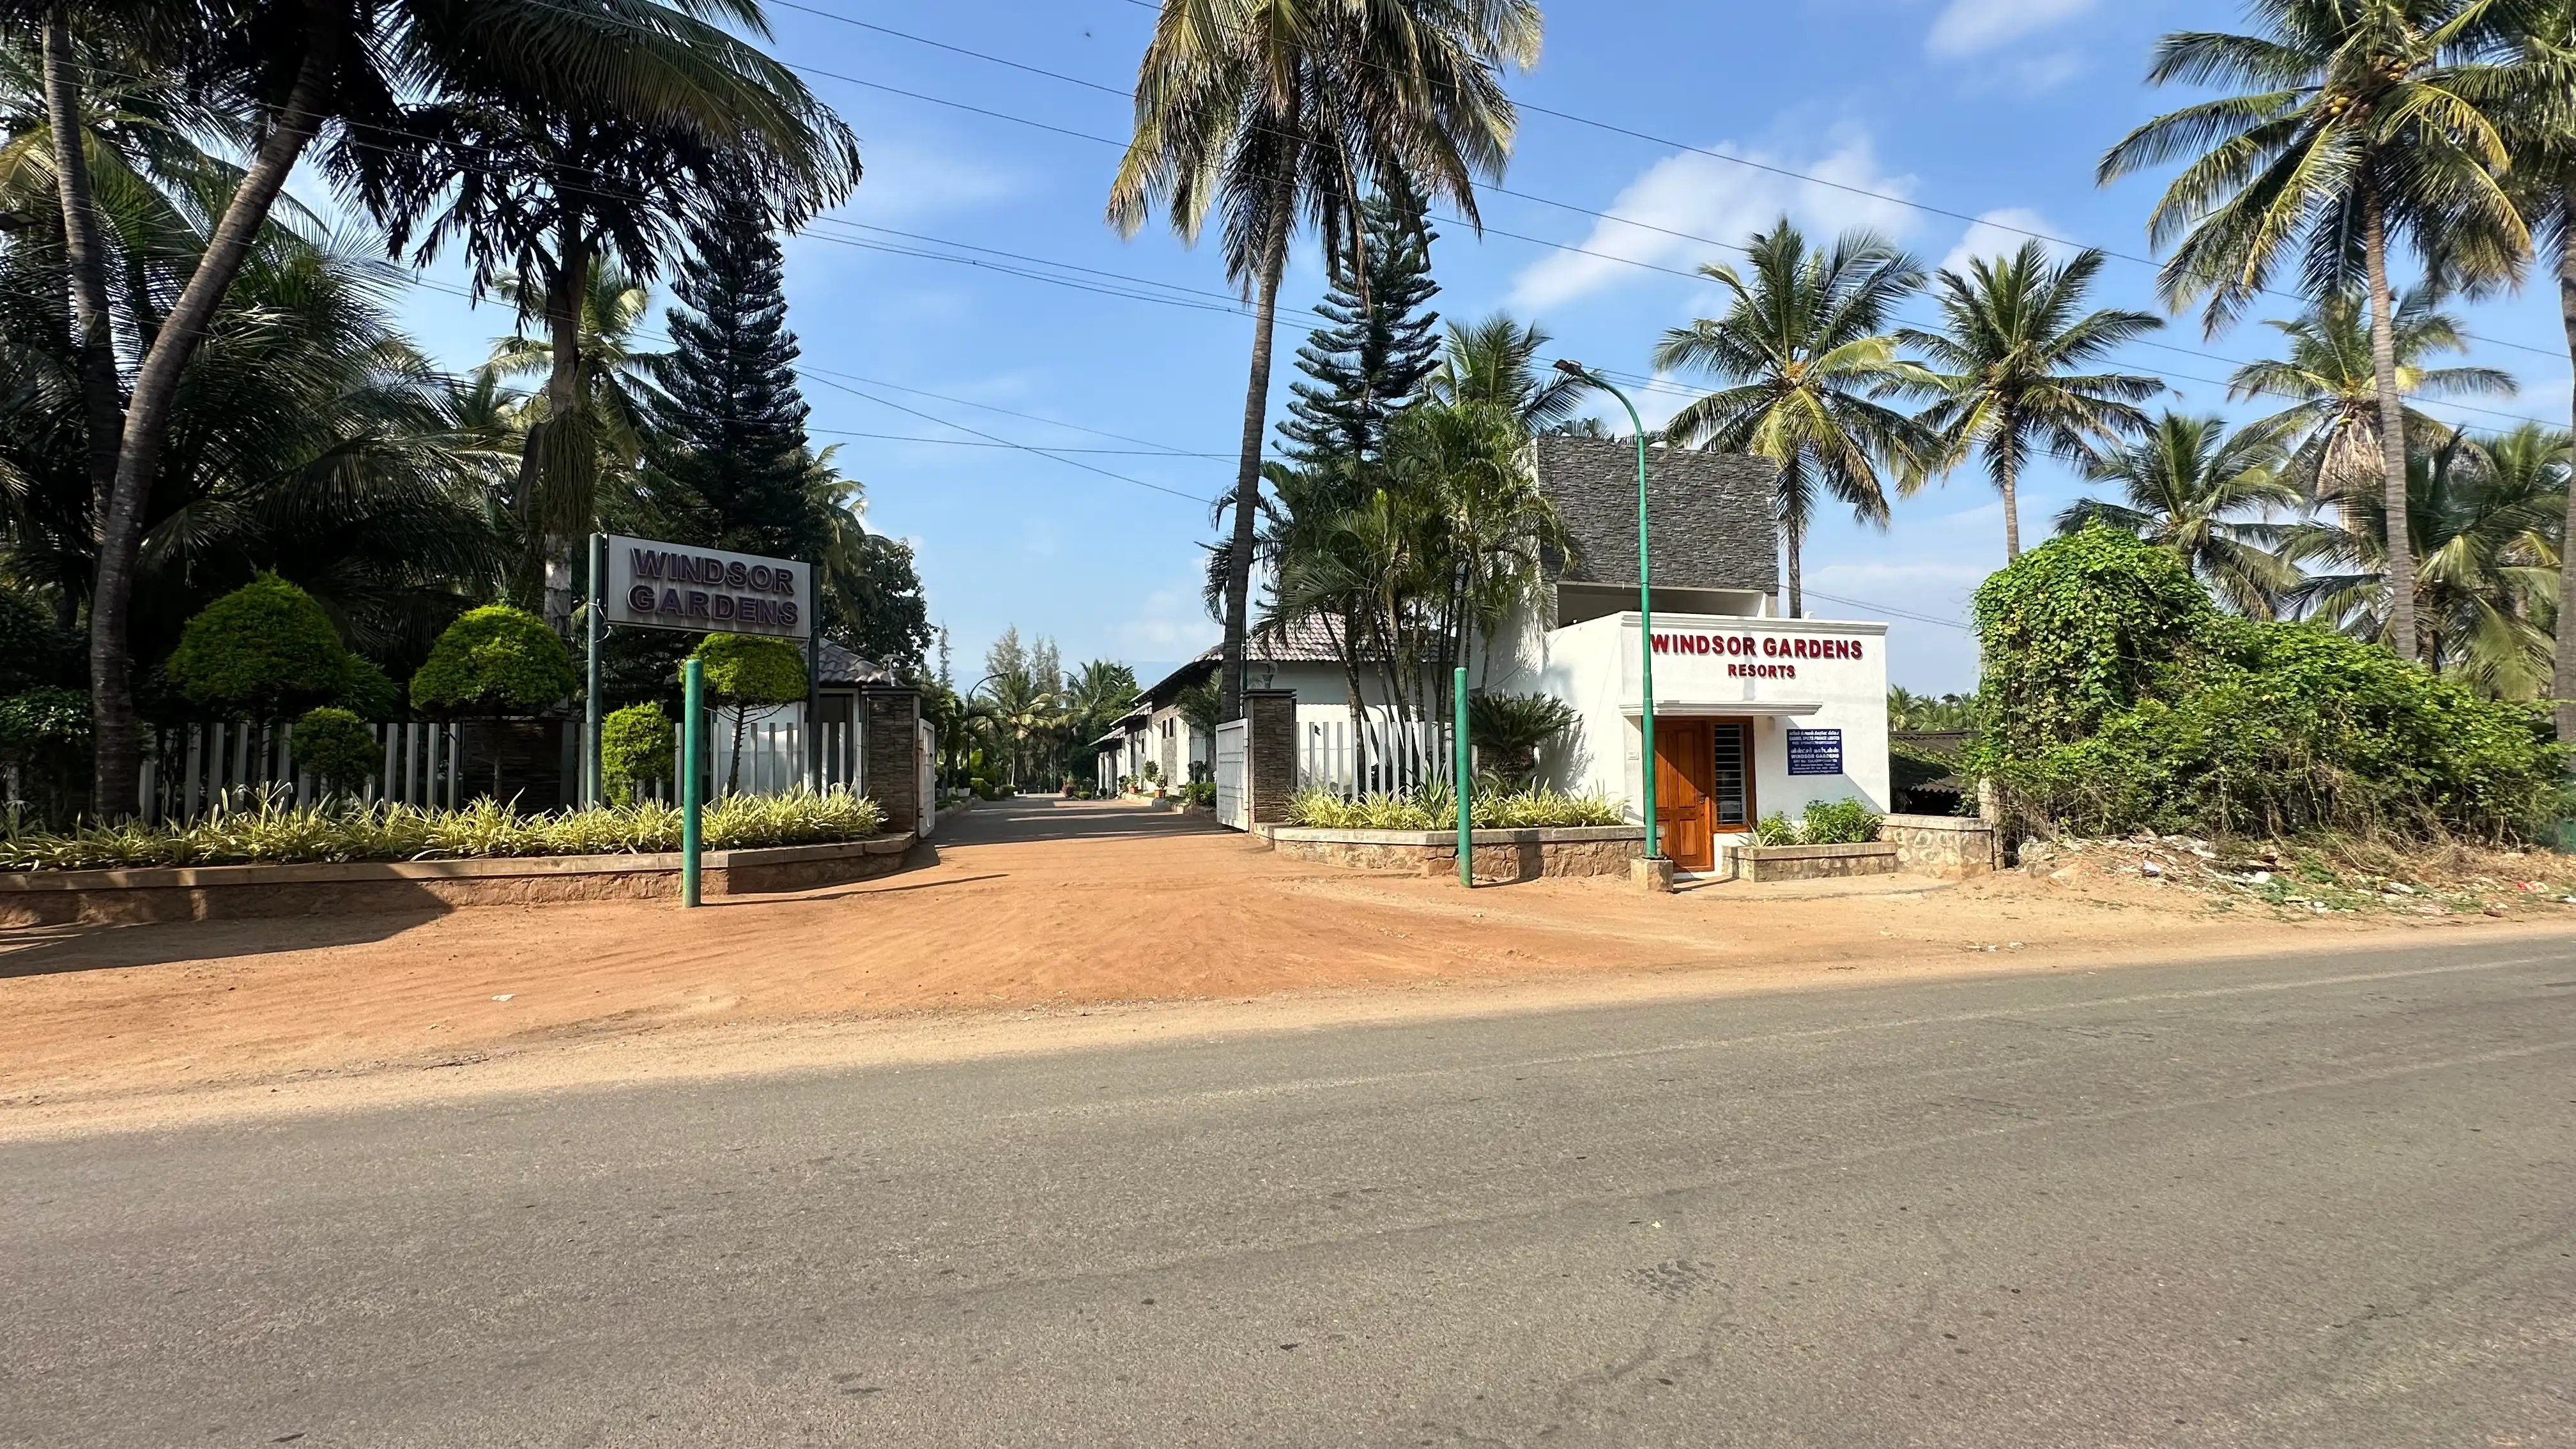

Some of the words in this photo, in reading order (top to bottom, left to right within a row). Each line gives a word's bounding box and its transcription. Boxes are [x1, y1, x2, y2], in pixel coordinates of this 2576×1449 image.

[630, 547, 795, 594] WINDSOR
[627, 585, 799, 626] GARDENS
[1651, 634, 1756, 656] WINDSOR
[1763, 638, 1863, 659] GARDENS
[1728, 664, 1796, 678] RESORTS
